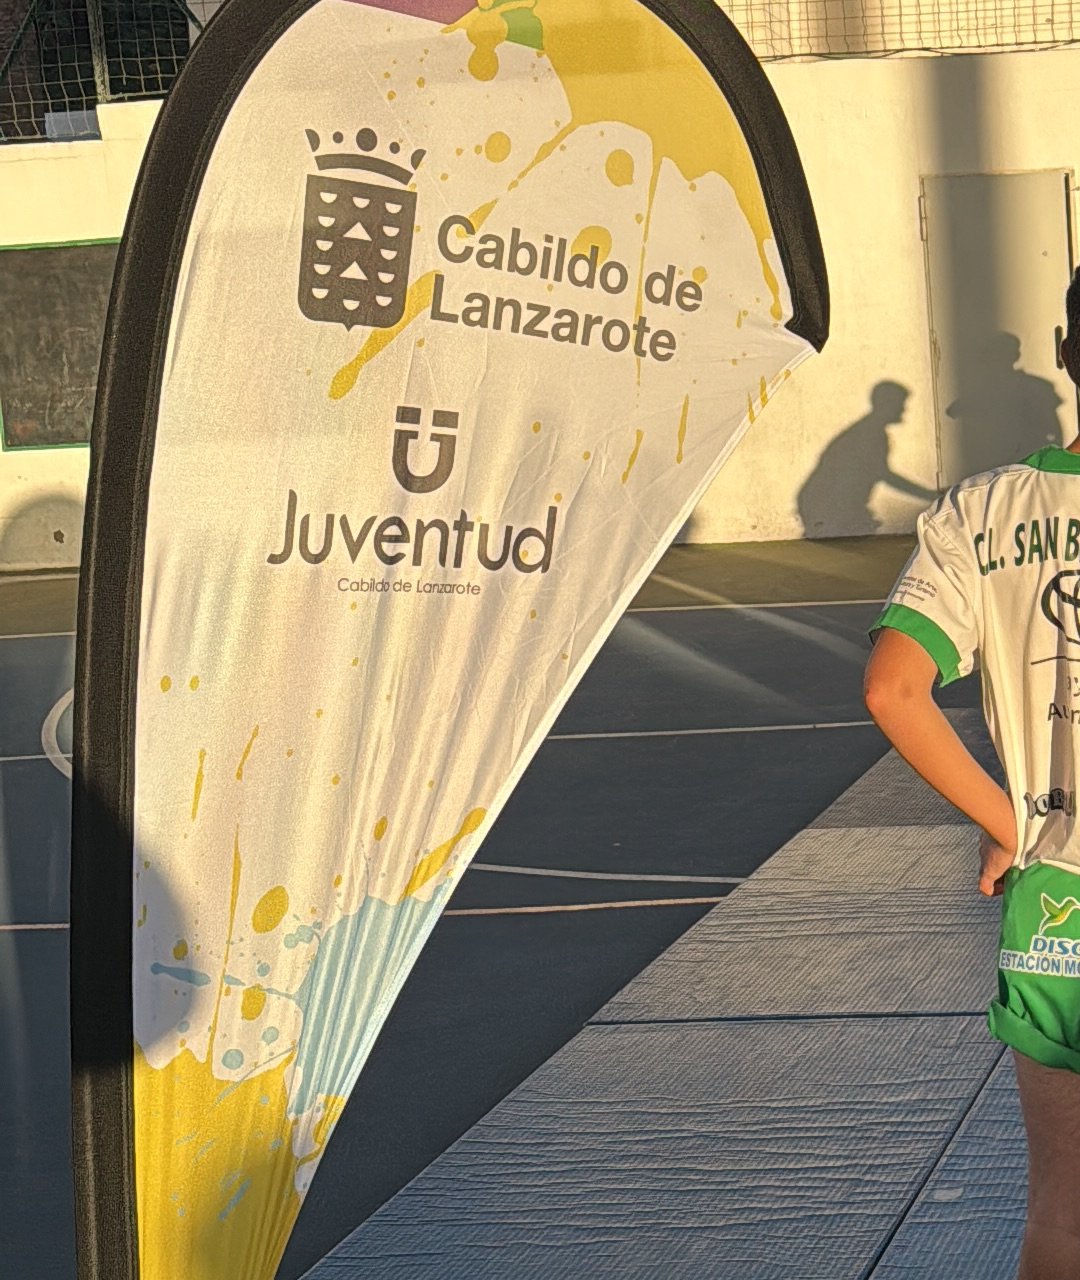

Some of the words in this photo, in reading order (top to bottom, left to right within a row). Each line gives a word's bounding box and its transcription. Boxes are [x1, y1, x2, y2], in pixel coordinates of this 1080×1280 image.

[437, 214, 628, 296] Cabildo
[644, 264, 704, 313] de
[430, 273, 677, 363] Lanzarote
[267, 488, 558, 575] Juventud
[1014, 516, 1060, 567] SAN
[337, 577, 390, 593] Cabildo
[392, 578, 413, 593] de
[416, 579, 481, 596] Lanzarote
